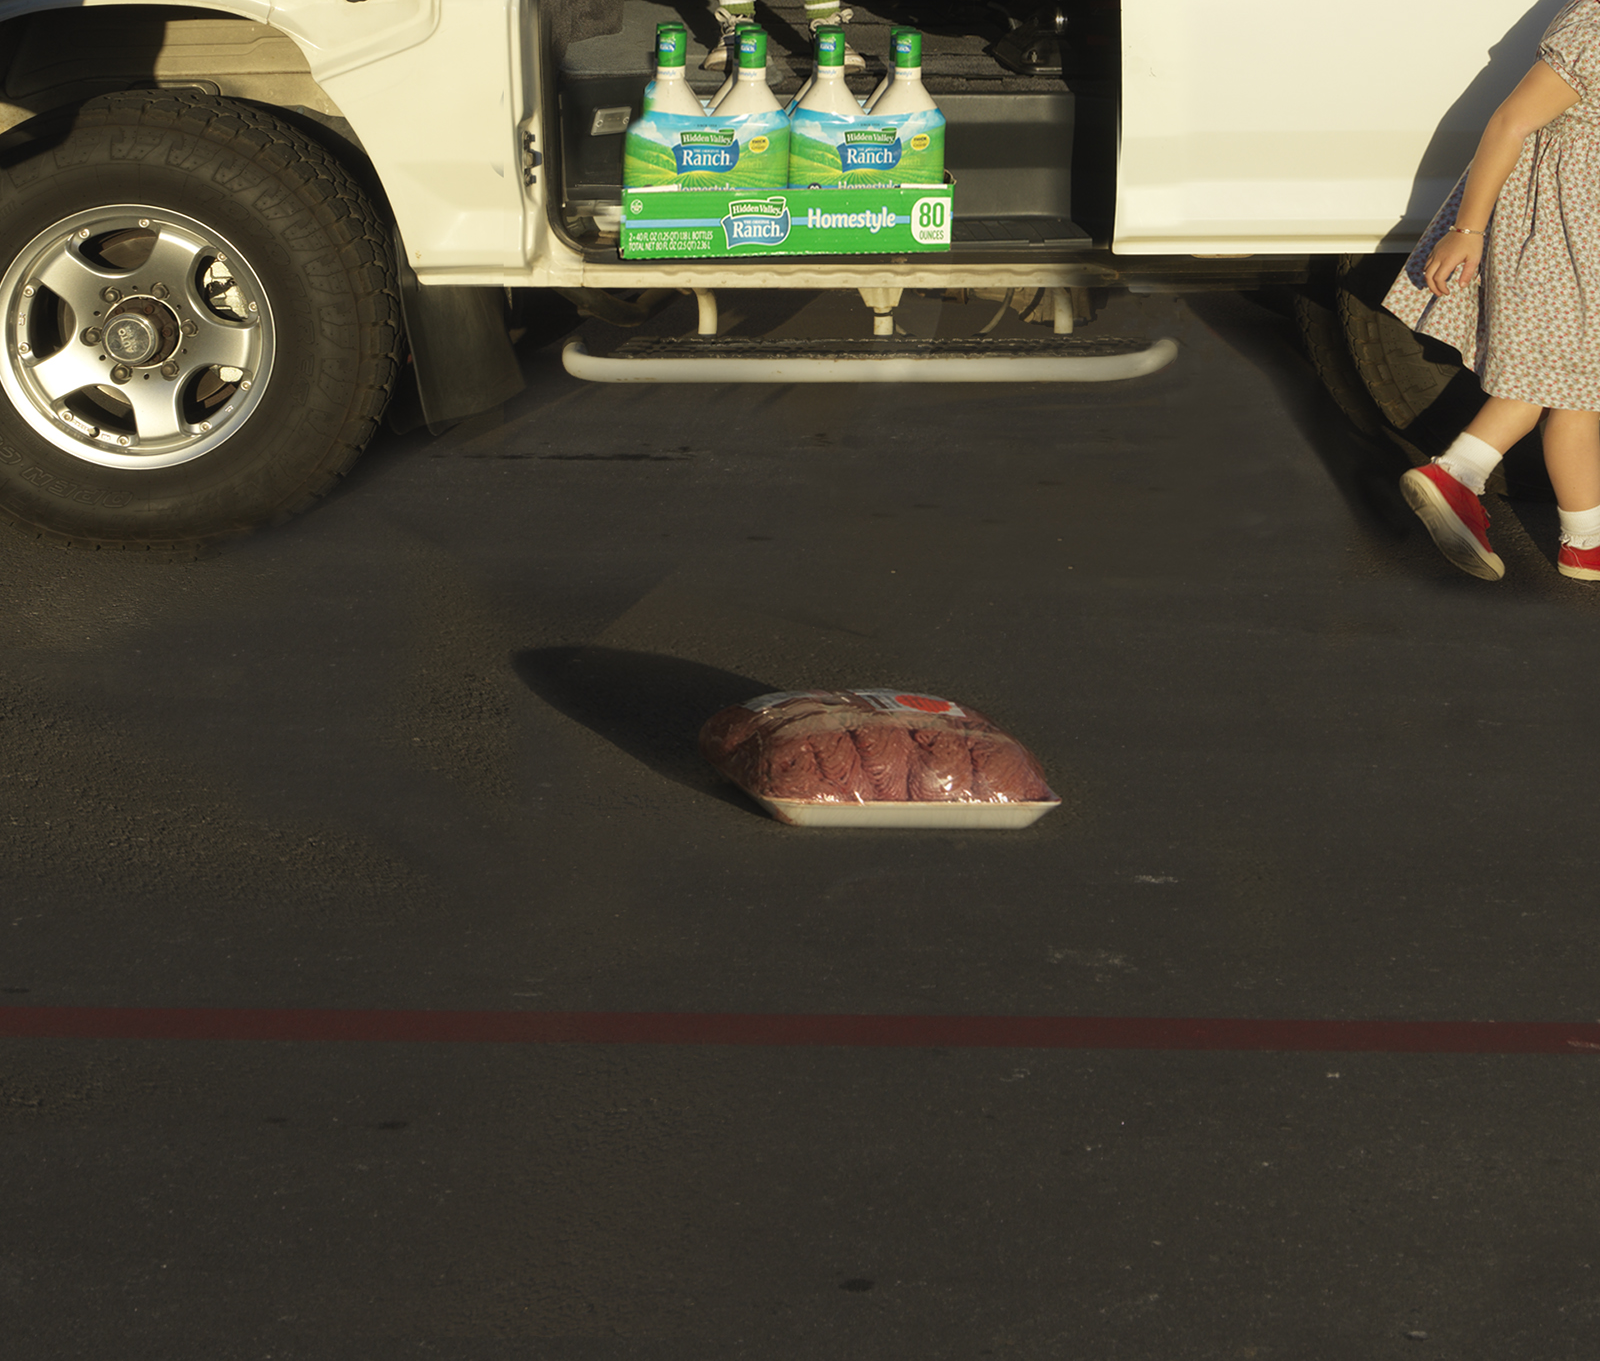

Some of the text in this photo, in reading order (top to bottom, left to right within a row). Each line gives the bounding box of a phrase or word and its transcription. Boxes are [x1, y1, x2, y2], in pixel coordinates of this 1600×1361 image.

[683, 132, 732, 145] Hidden Valley
[847, 132, 894, 144] Hidden Valley
[733, 202, 782, 216] Hidden Valley
[919, 202, 944, 228] 80
[807, 206, 896, 234] Homestyle
[649, 231, 657, 241] OZ
[692, 230, 713, 240] BOTTLES
[919, 230, 944, 240] OUNCES
[629, 242, 644, 251] TOTAL
[644, 242, 655, 251] NET
[655, 242, 662, 251] 80
[669, 241, 676, 250] OZ
[117, 328, 134, 353] AUTO
